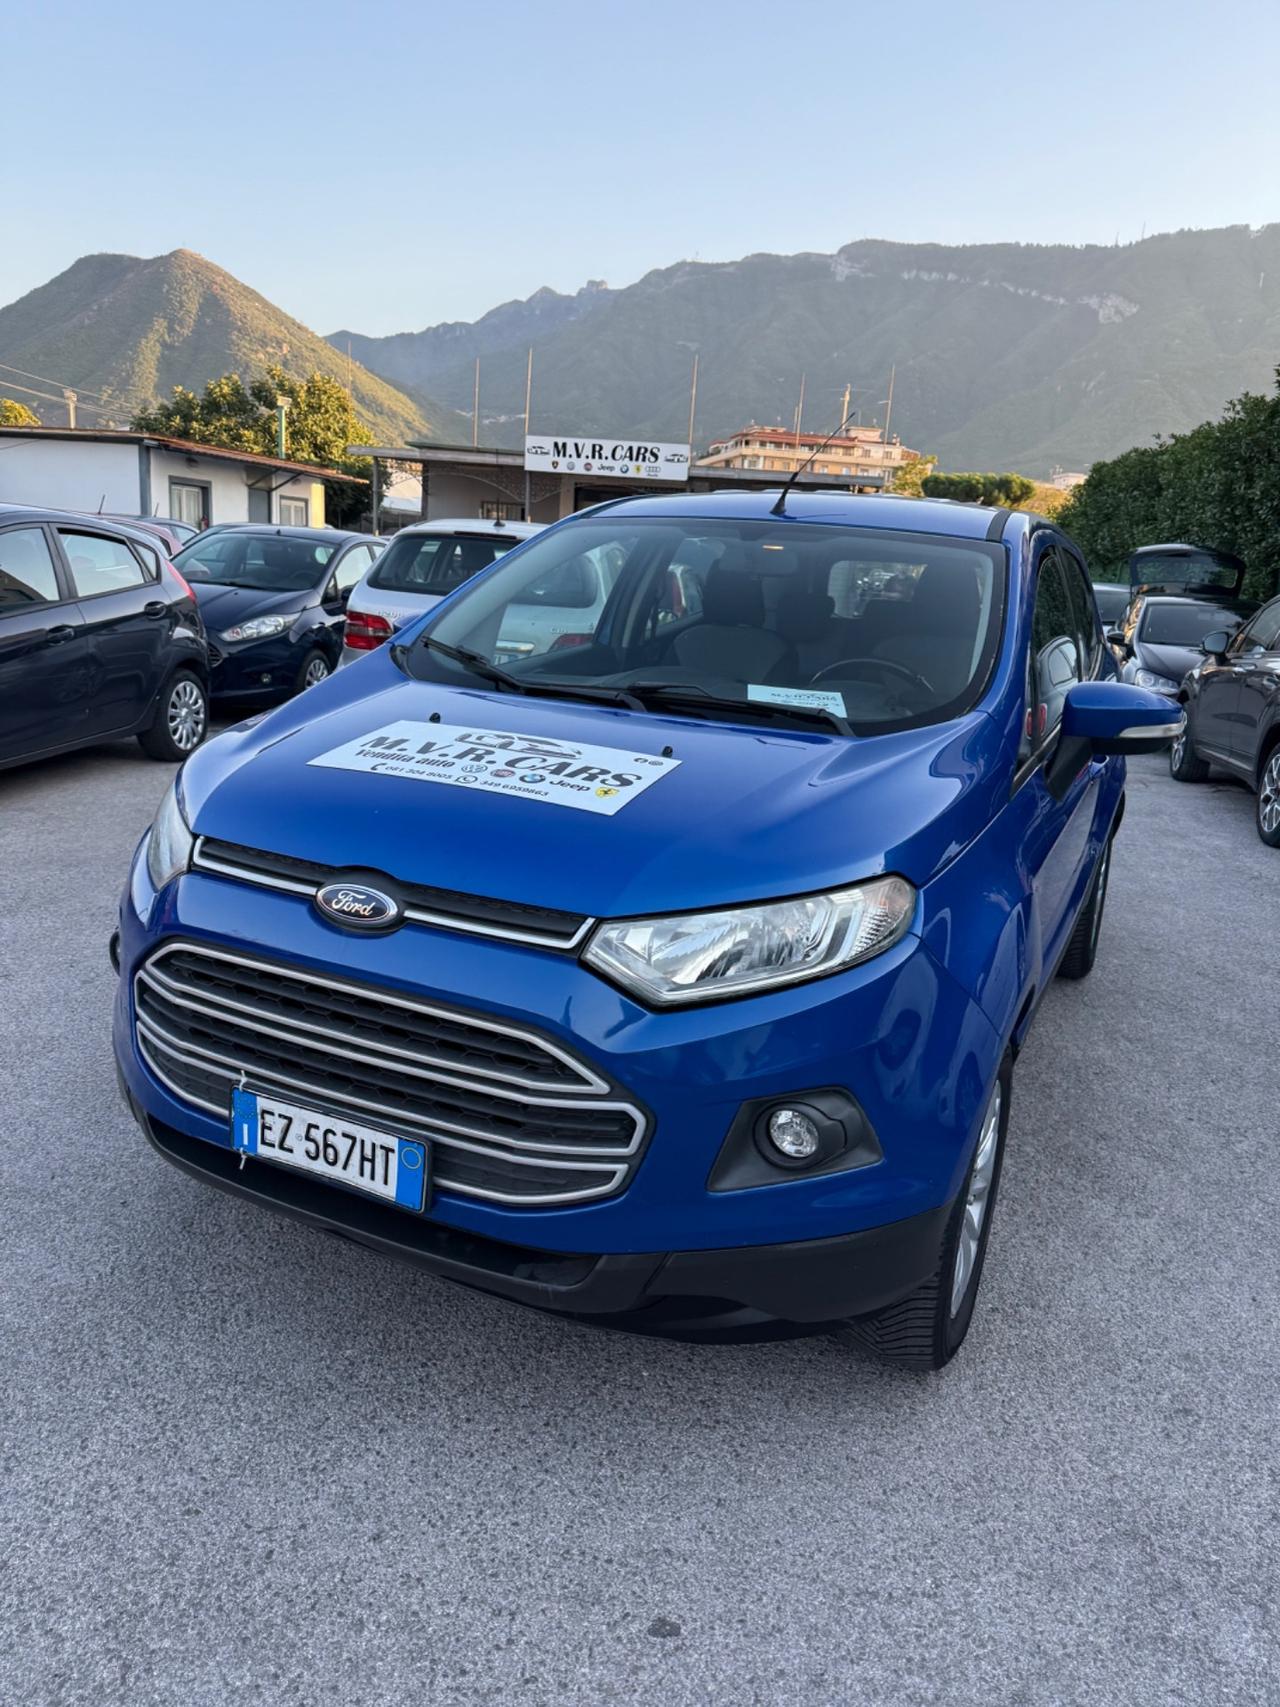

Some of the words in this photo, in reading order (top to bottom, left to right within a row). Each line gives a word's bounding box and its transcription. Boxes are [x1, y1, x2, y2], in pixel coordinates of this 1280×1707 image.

[355, 749, 415, 763] Vendita
[416, 757, 456, 768] auto
[549, 779, 591, 793] Jeep
[331, 890, 376, 916] Ford
[260, 1109, 294, 1154] EZ
[304, 1122, 396, 1186] 567HT
